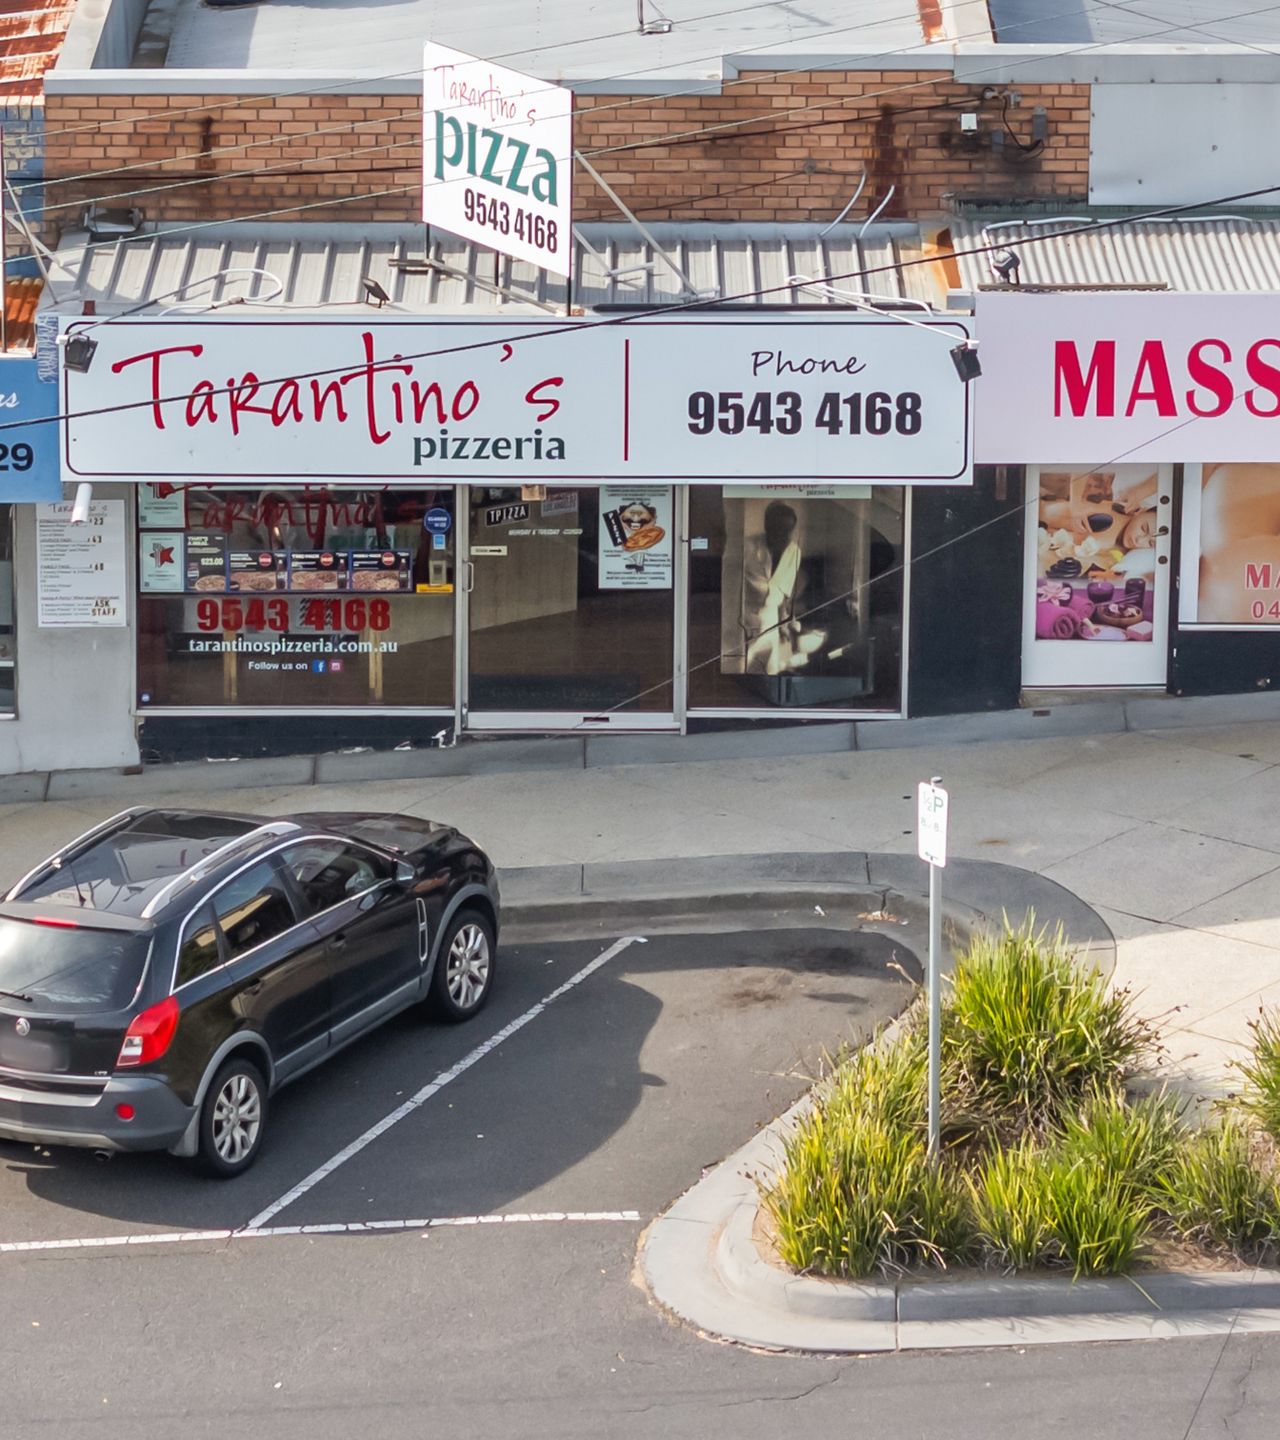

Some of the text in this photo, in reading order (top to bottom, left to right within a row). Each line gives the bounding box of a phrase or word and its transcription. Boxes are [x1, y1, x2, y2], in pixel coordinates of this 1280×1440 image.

[434, 65, 537, 127] Tarantino's
[434, 109, 559, 207] pizza
[463, 188, 559, 254] 9543 4168
[750, 349, 866, 377] Phone
[112, 331, 565, 446] Tarantino's
[687, 391, 922, 437] 9543 4168
[412, 428, 566, 467] pizzeria
[196, 598, 391, 632] 9543 4168
[188, 638, 398, 655] tarantinospizzeria.com.au
[248, 661, 278, 670] Follow
